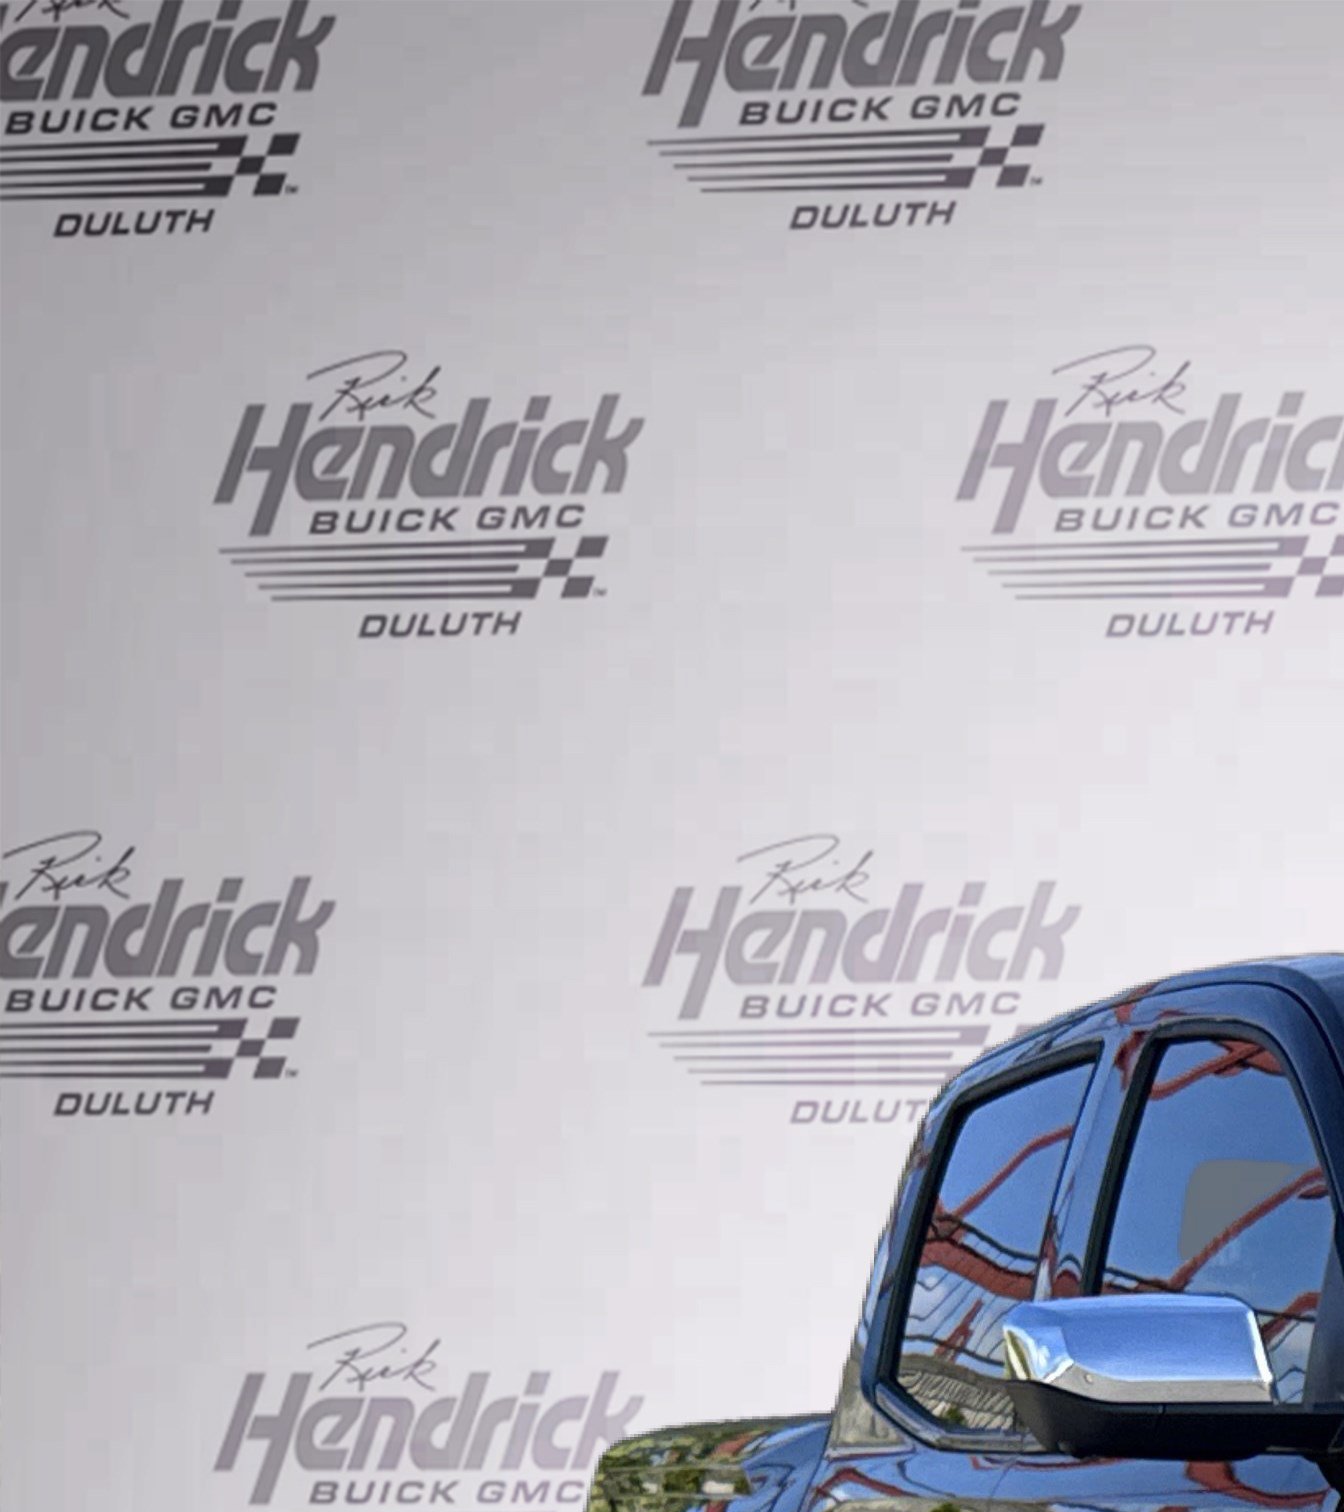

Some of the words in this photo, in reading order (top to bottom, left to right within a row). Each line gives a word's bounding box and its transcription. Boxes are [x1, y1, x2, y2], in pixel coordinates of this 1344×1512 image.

[0, 0, 337, 103] endrick
[4, 105, 155, 136] BUICK
[169, 101, 278, 130] GMC
[738, 96, 894, 127] BUICK
[909, 91, 1022, 120] GMC
[52, 208, 216, 238] DULUTH
[788, 200, 957, 231] DULUTH
[213, 393, 645, 538] Hendrick
[308, 506, 460, 535] BUICK
[476, 503, 585, 531] GMC
[1054, 504, 1210, 533] BUICK
[1227, 501, 1340, 528] GMC
[357, 610, 522, 639] DULUTH
[1105, 610, 1275, 638] DULUTH
[0, 875, 337, 981] endrick
[641, 880, 1082, 1021] Hendrick
[3, 986, 155, 1014] BUICK
[169, 984, 278, 1012] GMC
[738, 993, 893, 1020] BUICK
[909, 992, 1020, 1017] GMC
[52, 1089, 216, 1117] DULUTH
[789, 1100, 927, 1124] DULUT
[212, 1370, 645, 1506] Hendrick
[308, 1479, 460, 1505] BUICK
[476, 1480, 585, 1504] GMC
